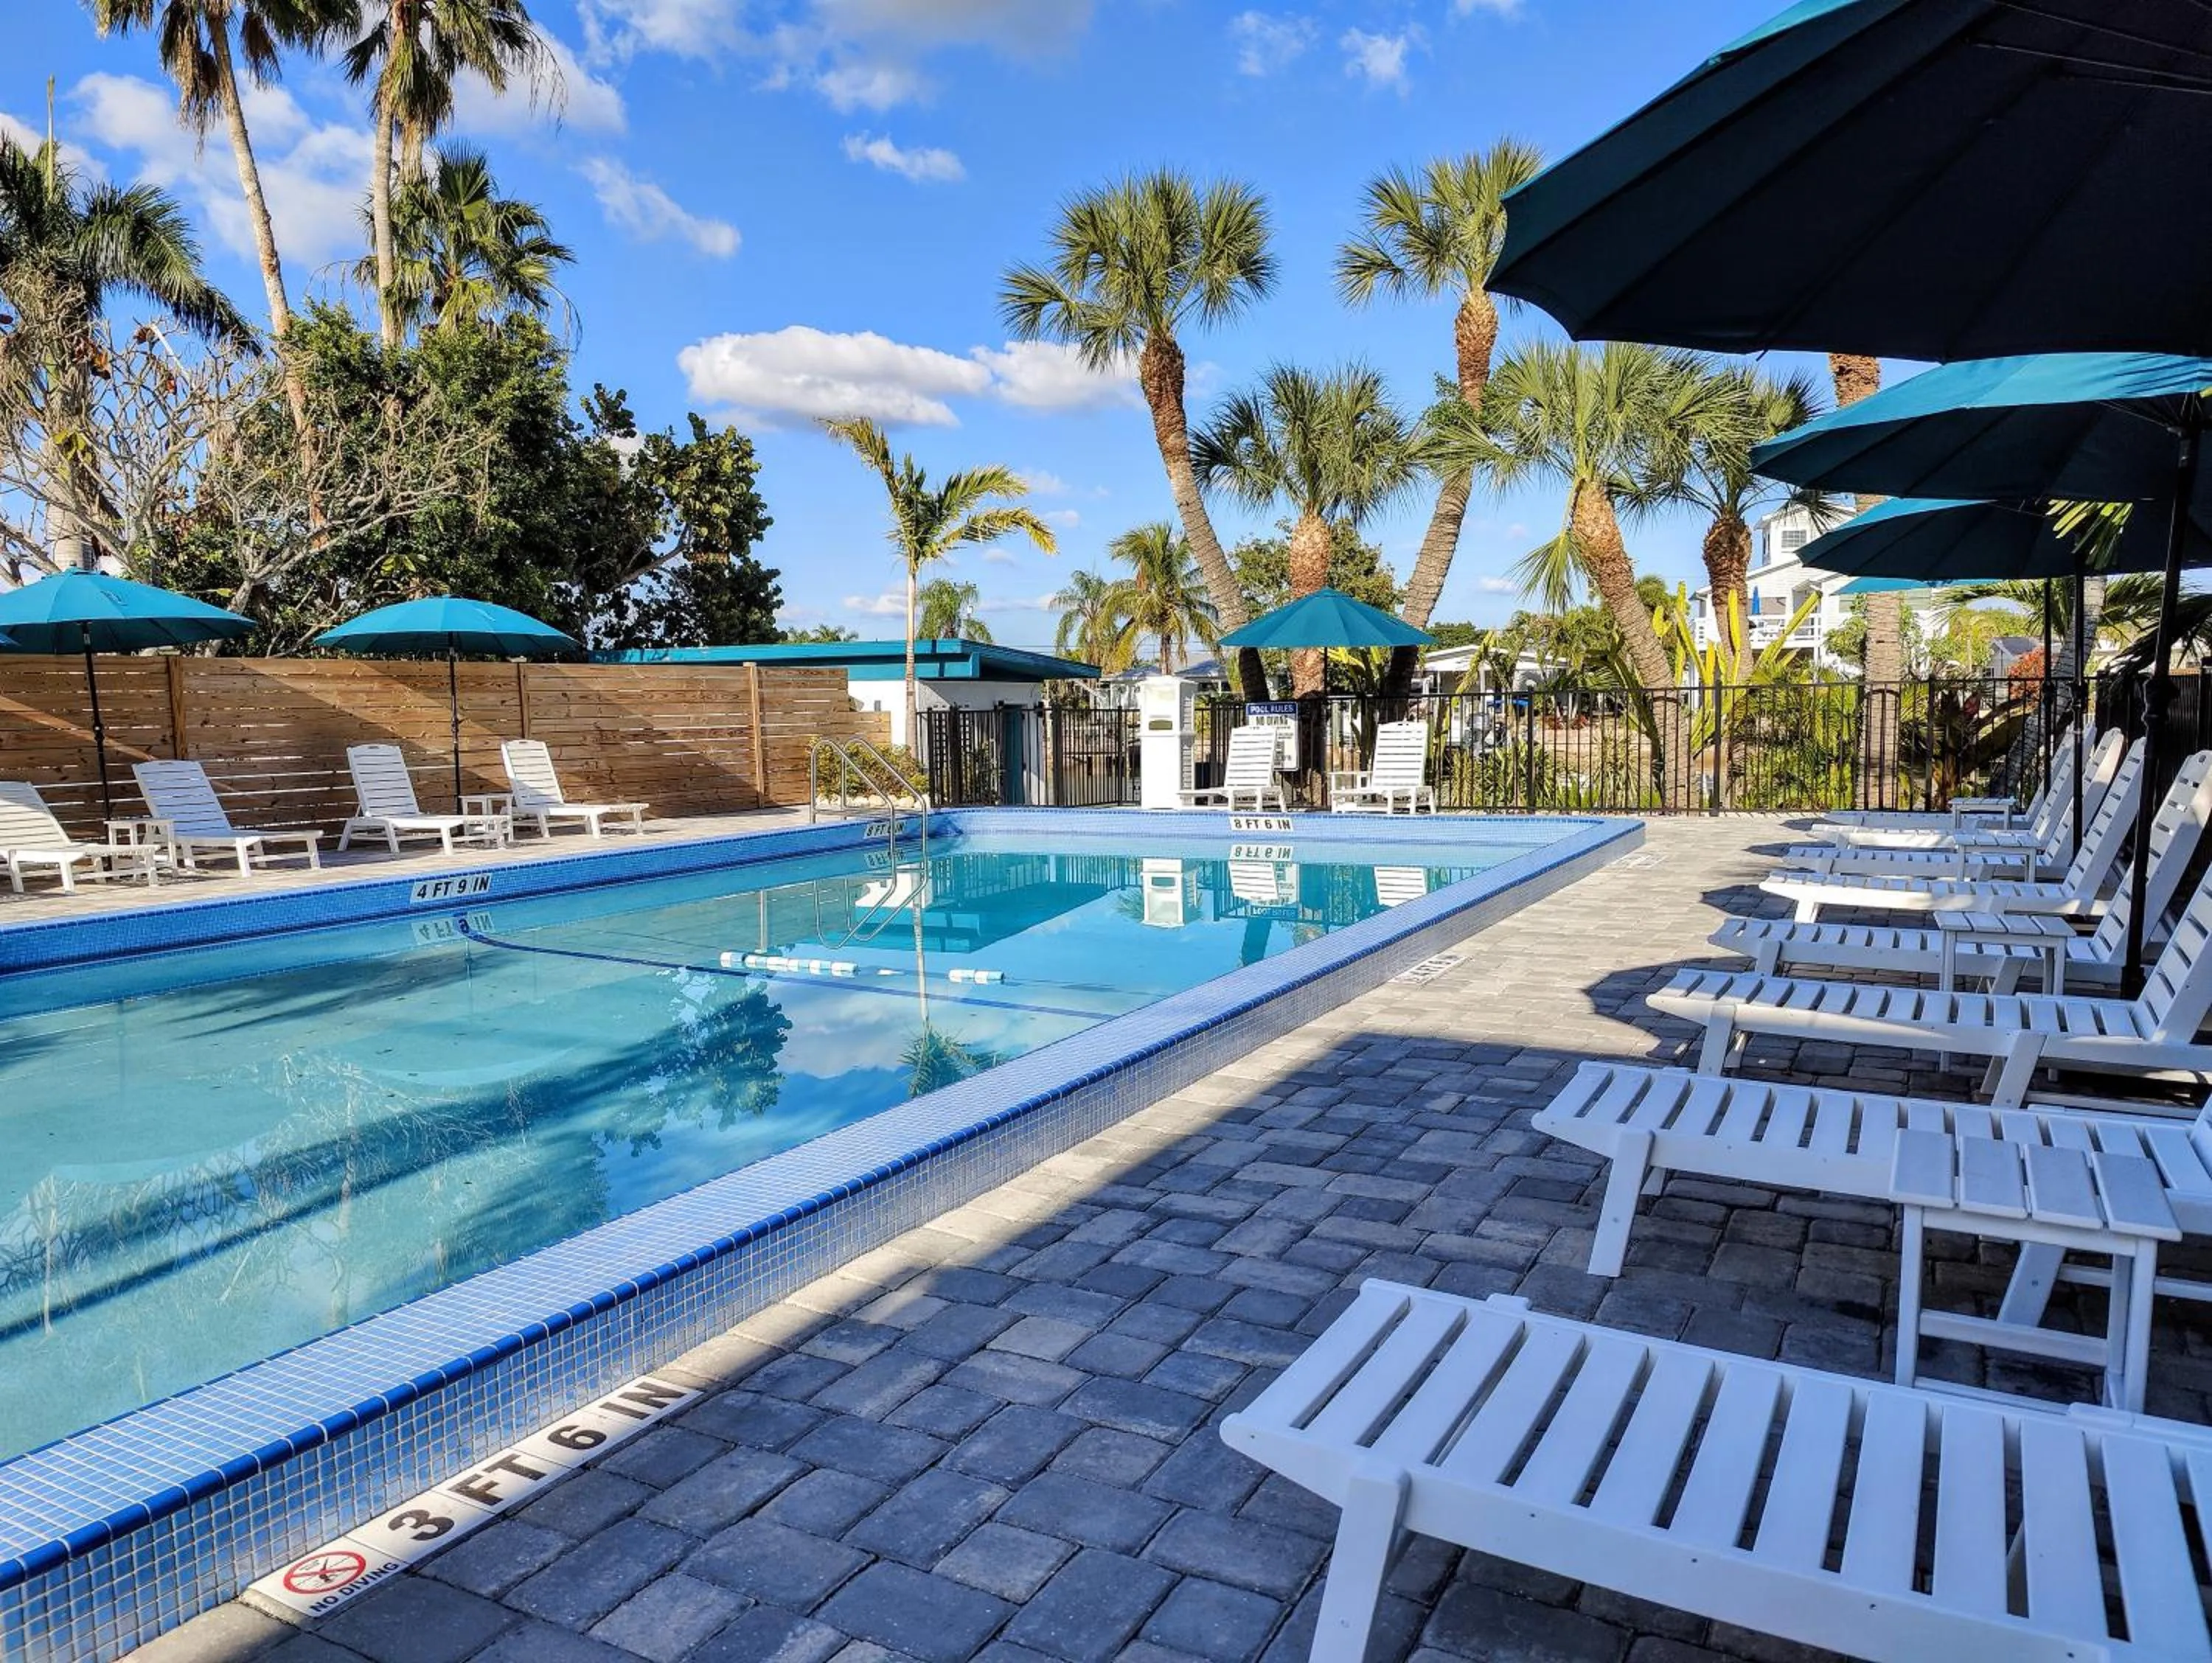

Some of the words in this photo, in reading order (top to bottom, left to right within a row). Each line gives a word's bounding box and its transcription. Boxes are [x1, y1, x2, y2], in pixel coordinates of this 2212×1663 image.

[1250, 705, 1268, 714] POOL
[1270, 704, 1294, 713] RULES
[1234, 818, 1242, 829] 8
[1245, 818, 1259, 829] FT
[1265, 819, 1273, 829] 6
[1277, 819, 1291, 830] IN
[417, 884, 428, 899] 4
[432, 881, 452, 897] FT
[457, 879, 467, 893] 9
[473, 875, 490, 892] IN
[387, 1508, 455, 1542] 3
[448, 1453, 548, 1507] FT
[546, 1424, 608, 1451] 6
[599, 1381, 686, 1420] IN
[310, 1595, 338, 1612] NO
[338, 1562, 400, 1596] DIVING
